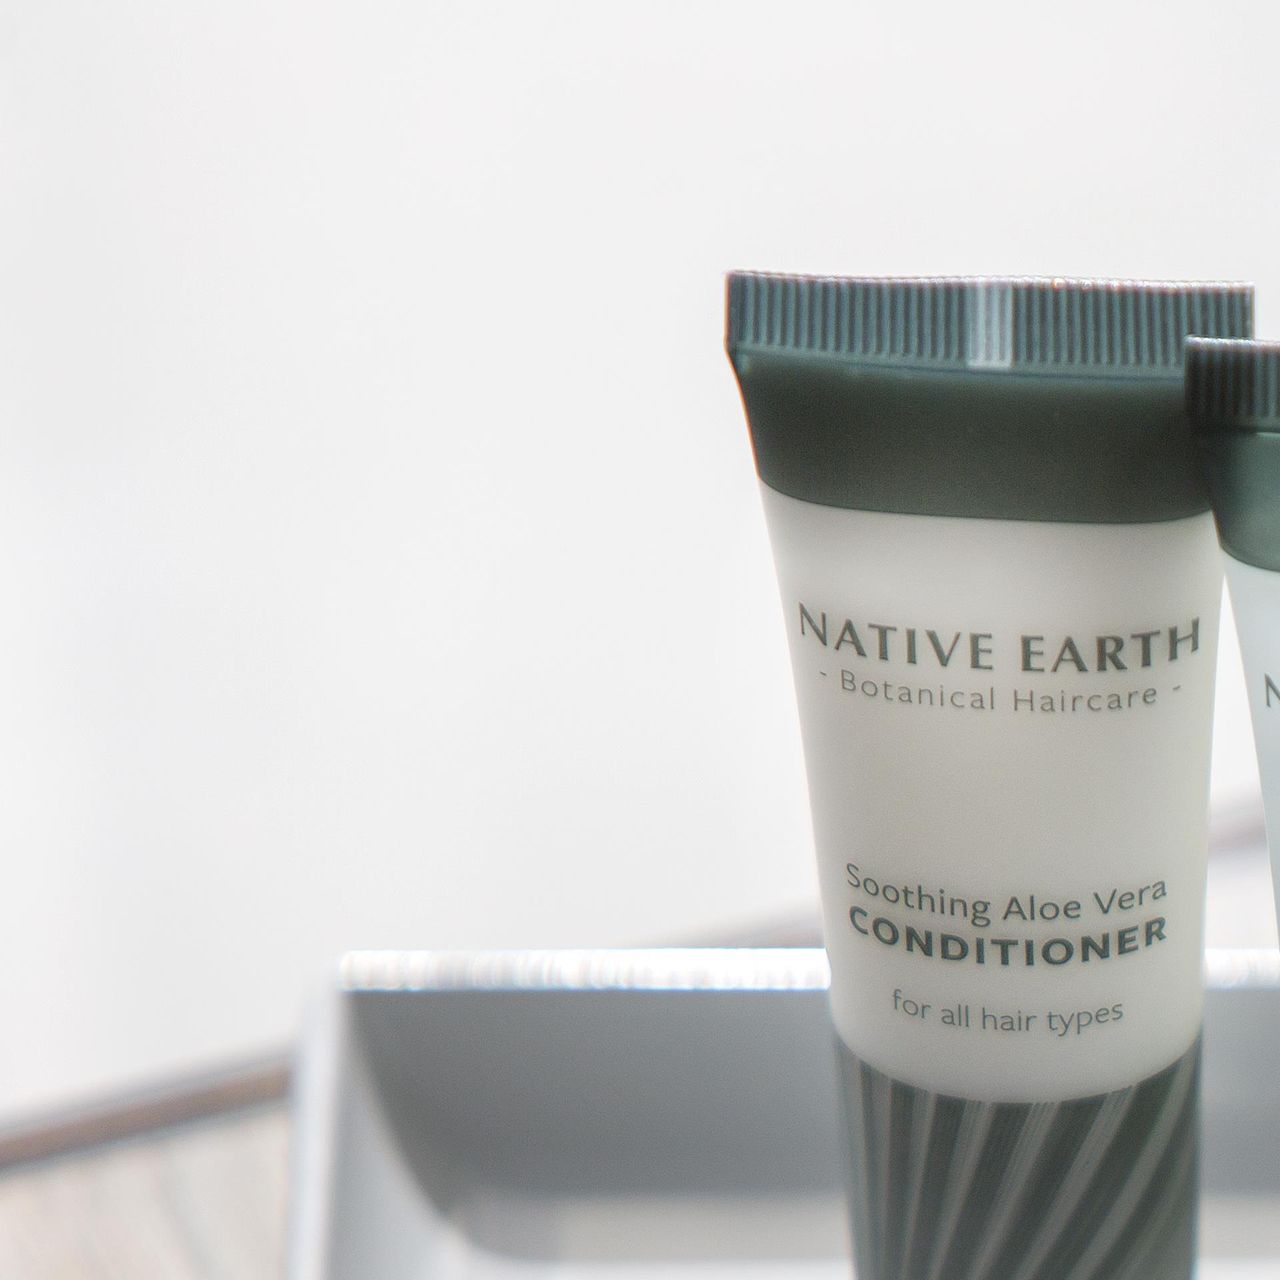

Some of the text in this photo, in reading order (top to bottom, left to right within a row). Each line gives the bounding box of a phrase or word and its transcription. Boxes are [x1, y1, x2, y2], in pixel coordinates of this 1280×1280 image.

[799, 602, 1200, 672] NATIVE EARTH
[840, 670, 995, 710] Botanical
[1014, 688, 1158, 712] Haircare
[846, 862, 1167, 927] Soothing Aloe Vera
[849, 905, 1167, 966] CONDITIONER
[892, 989, 1124, 1037] for all hair types
